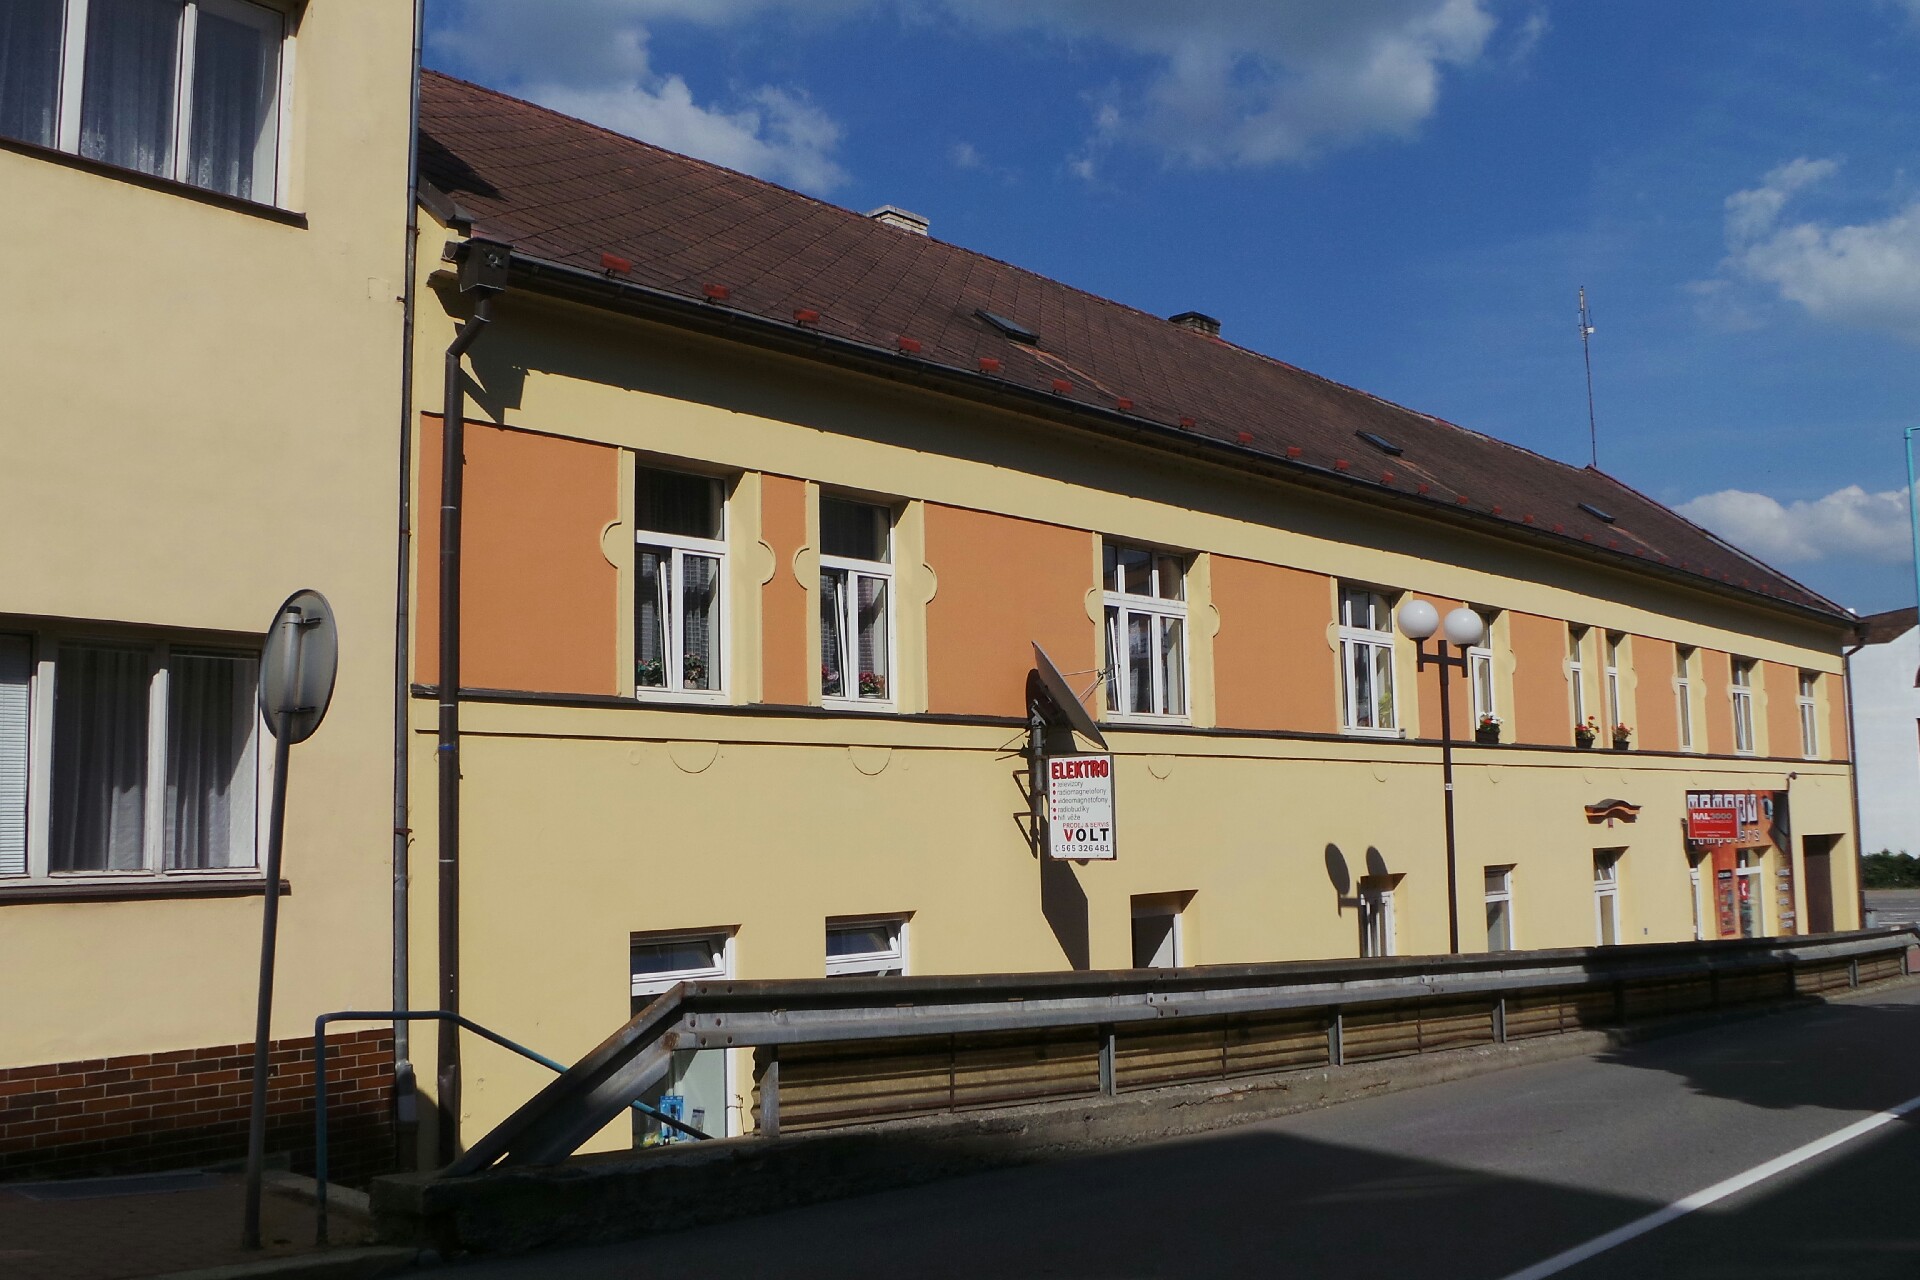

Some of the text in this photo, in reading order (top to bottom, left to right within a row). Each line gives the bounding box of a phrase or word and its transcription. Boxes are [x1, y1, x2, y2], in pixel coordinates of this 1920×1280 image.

[1051, 760, 1109, 779] ELEKTRO
[1063, 828, 1109, 842] VOLT
[1061, 844, 1076, 852] 565
